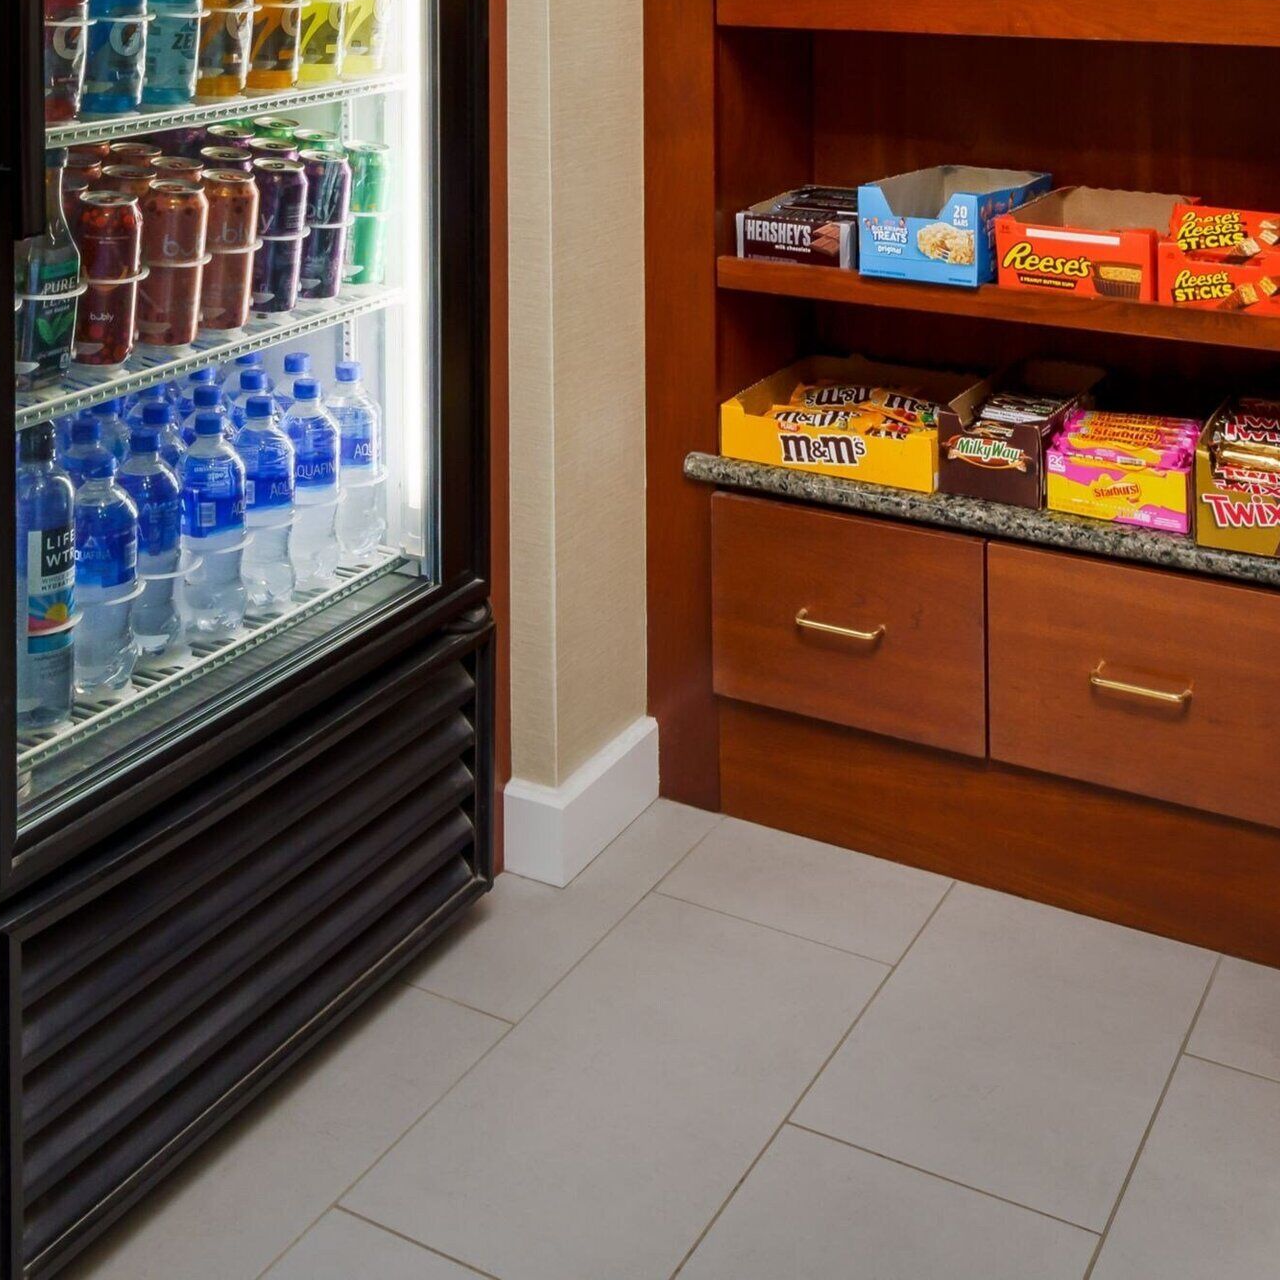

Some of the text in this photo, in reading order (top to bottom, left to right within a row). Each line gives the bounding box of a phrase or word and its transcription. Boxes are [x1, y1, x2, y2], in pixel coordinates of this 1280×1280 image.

[953, 205, 968, 219] 20
[953, 219, 969, 227] BARS
[1177, 220, 1242, 238] Reese's
[746, 219, 812, 246] HERSHEY'S
[872, 230, 908, 244] TREATS
[1177, 232, 1245, 251] STICKS
[877, 245, 902, 255] Original
[1002, 242, 1091, 277] Reese's
[42, 277, 77, 296] PURE
[1175, 269, 1229, 289] Reese's
[779, 434, 867, 466] m&m's
[1094, 483, 1141, 498] Starburst
